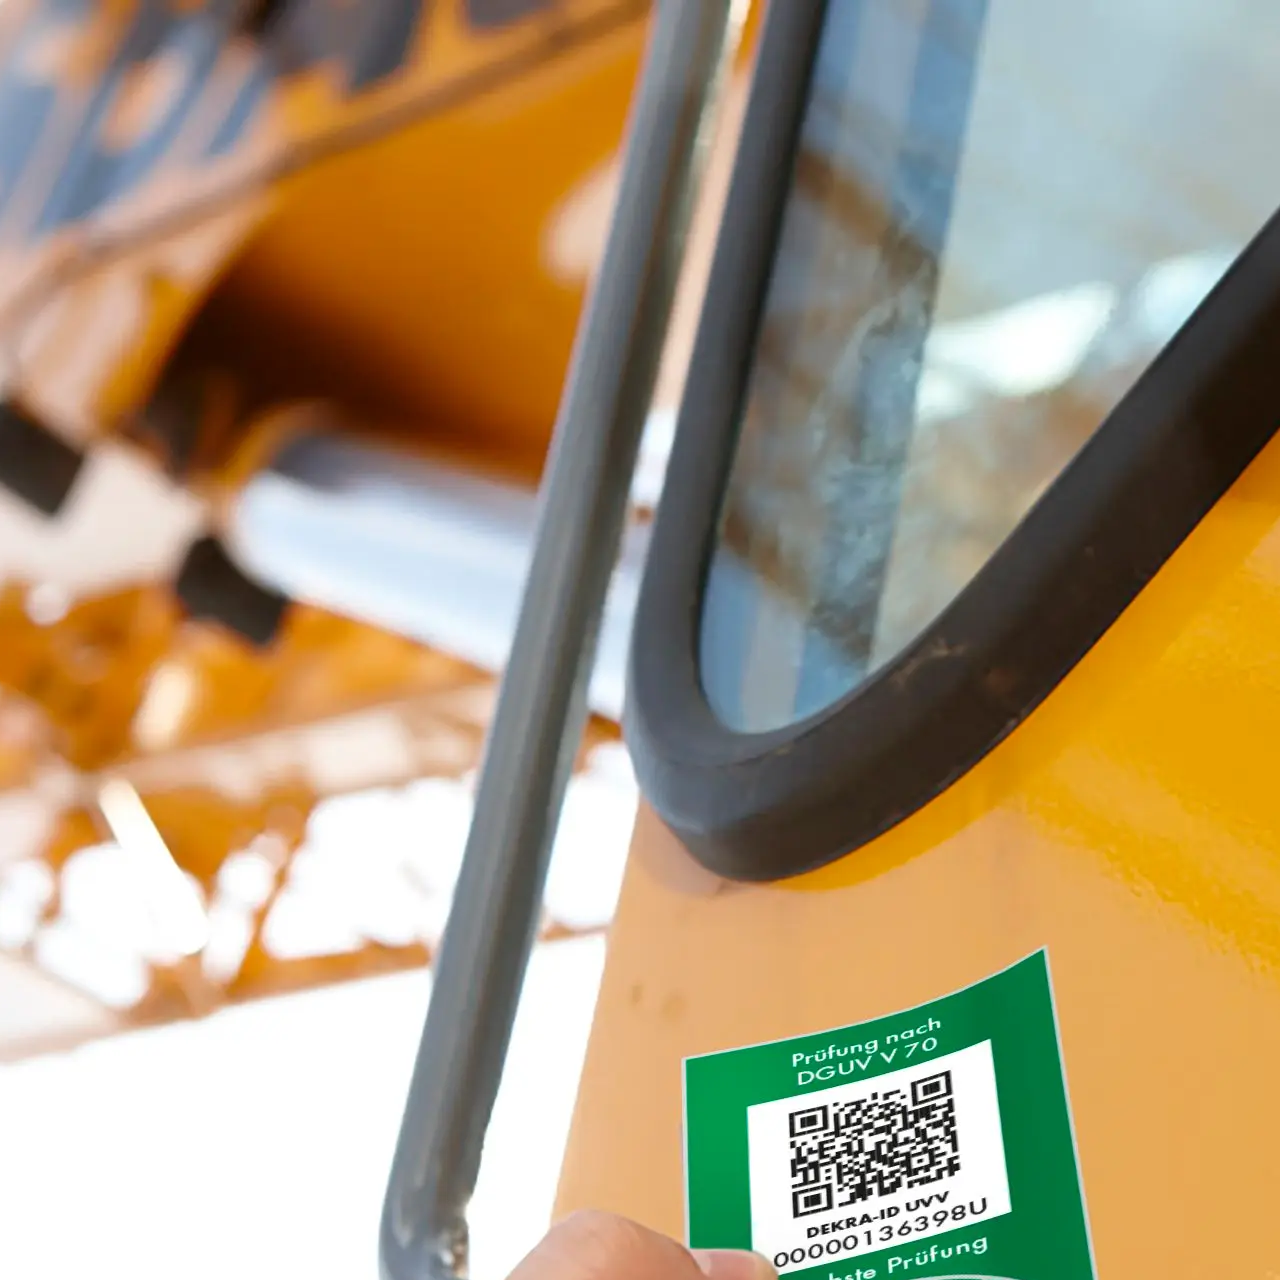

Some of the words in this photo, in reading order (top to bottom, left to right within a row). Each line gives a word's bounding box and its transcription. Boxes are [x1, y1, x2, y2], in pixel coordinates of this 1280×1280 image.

[792, 1040, 878, 1067] Prüfung
[886, 1017, 941, 1044] nach
[797, 1056, 872, 1085] DGUV
[879, 1048, 898, 1064] V
[904, 1037, 938, 1059] 70
[773, 1197, 988, 1268] 00000136398U
[806, 1206, 900, 1239] DEKRA-ID
[905, 1191, 949, 1212] UVV
[887, 1237, 988, 1273] Prüfung
